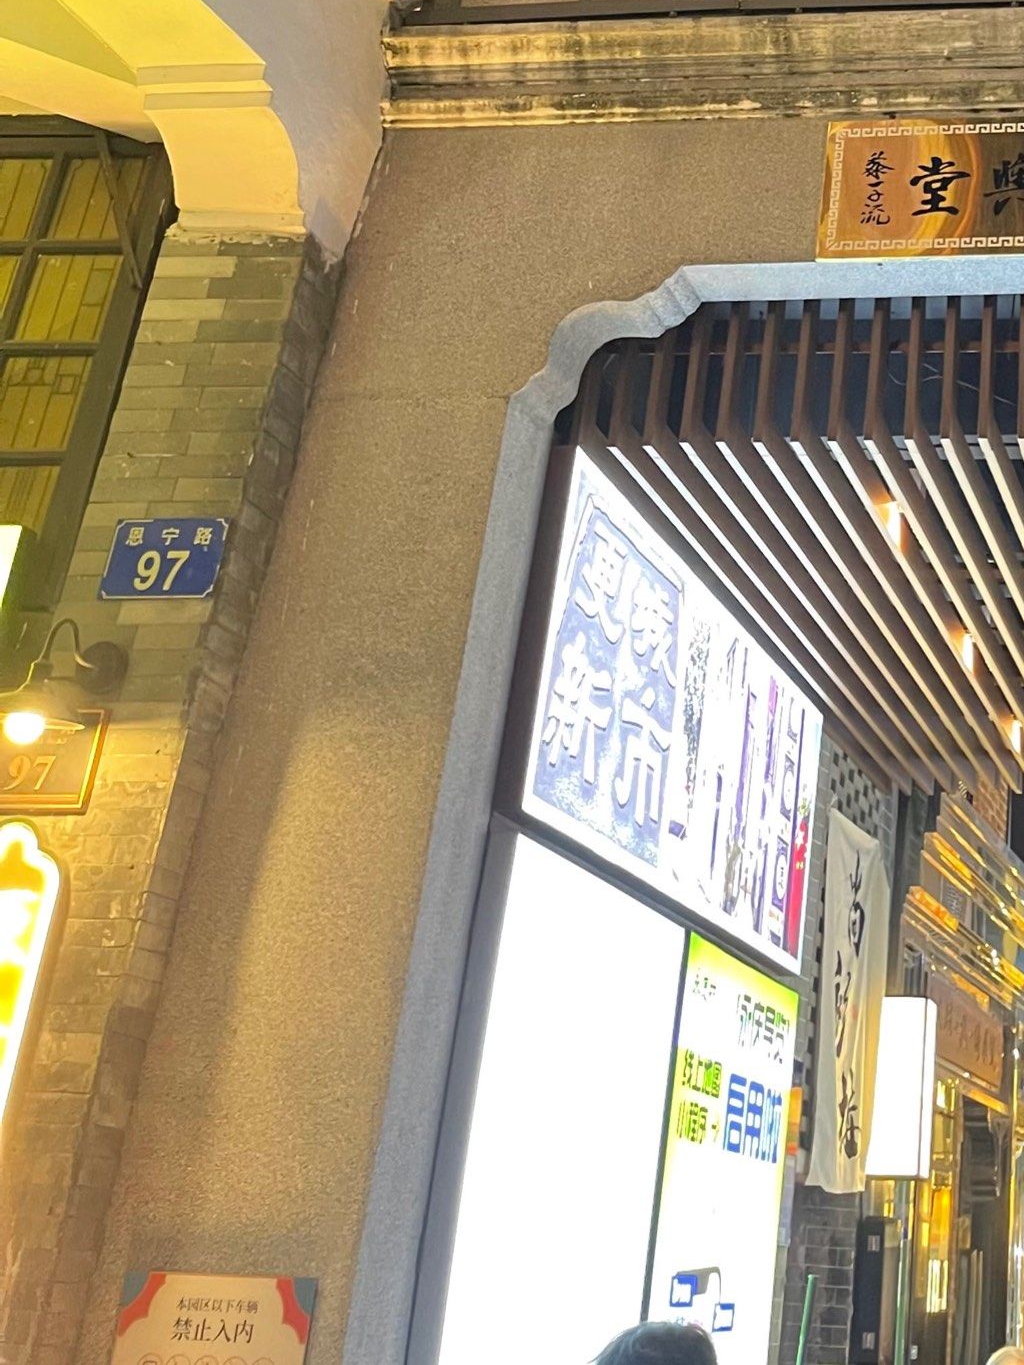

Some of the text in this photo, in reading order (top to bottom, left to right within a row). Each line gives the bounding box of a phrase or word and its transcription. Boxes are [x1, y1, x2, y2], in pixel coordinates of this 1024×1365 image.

[125, 526, 214, 546] 恩宁路
[133, 550, 191, 591] 97
[3, 755, 57, 791] 97
[169, 1316, 255, 1344] 禁止入内
